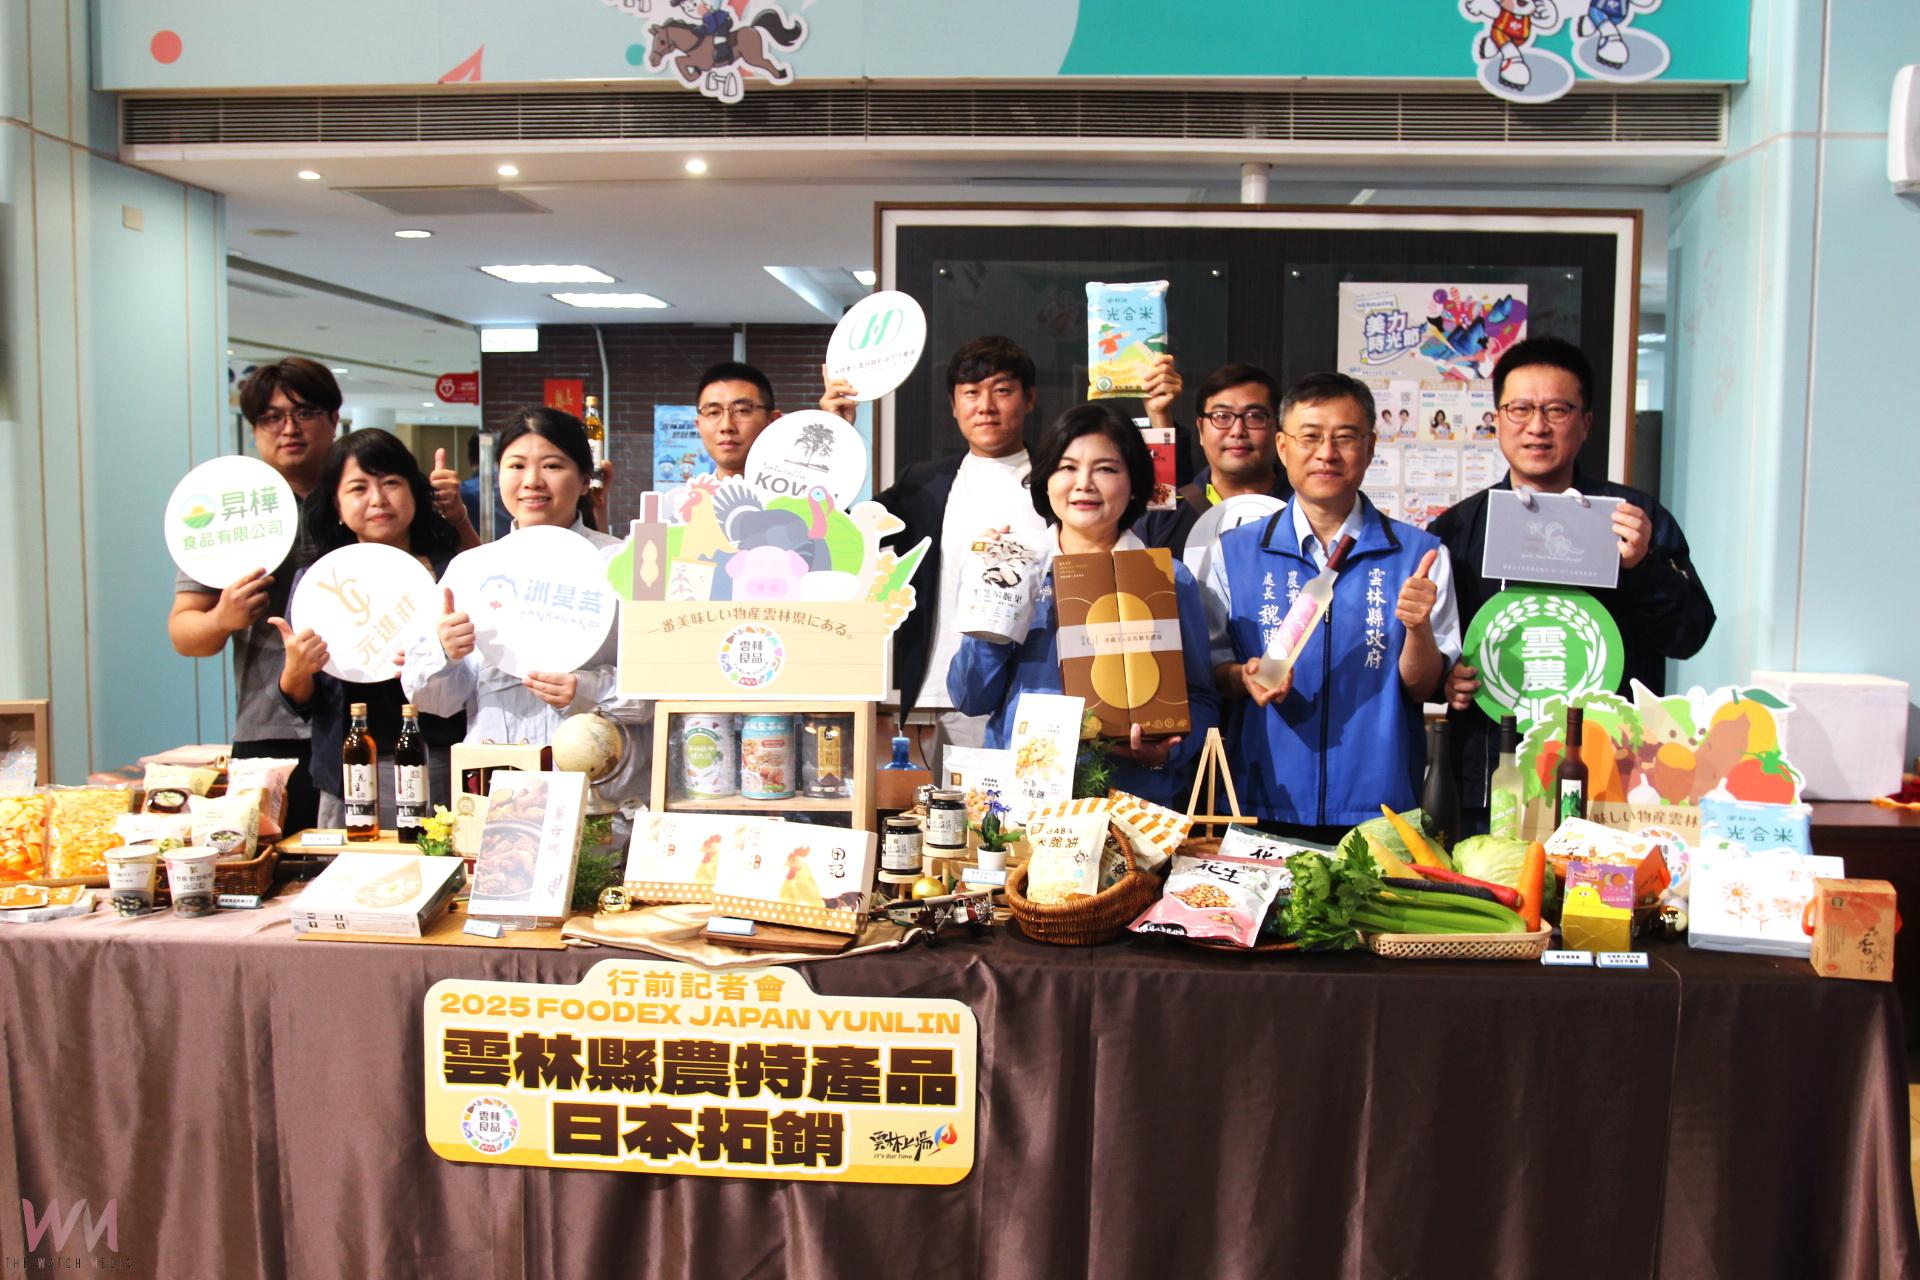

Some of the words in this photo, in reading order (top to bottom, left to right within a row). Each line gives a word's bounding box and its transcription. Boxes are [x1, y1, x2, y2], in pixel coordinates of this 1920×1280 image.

[1106, 305, 1153, 321] 光合米
[1366, 312, 1406, 336] 美力
[1368, 328, 1420, 352] 時光節
[221, 486, 279, 521] 昇樺
[183, 520, 283, 551] 食品有限公司
[648, 606, 854, 641] 一番美味しい物産雲林県にある。
[1365, 568, 1387, 670] 雲林縣政府
[1521, 627, 1568, 691] 雲農
[1727, 825, 1793, 843] 光合米
[1195, 859, 1240, 885] 花生
[607, 968, 787, 1003] 行前記者會
[440, 993, 531, 1018] 2025
[537, 998, 681, 1026] FOODEX
[689, 1004, 812, 1031] JAPAN
[817, 1010, 961, 1035] YUNLIN
[442, 1029, 959, 1107] 雲林縣農特產品
[479, 1111, 500, 1121] 雲林
[479, 1122, 500, 1133] 良品
[553, 1101, 845, 1168] 日本拓銷
